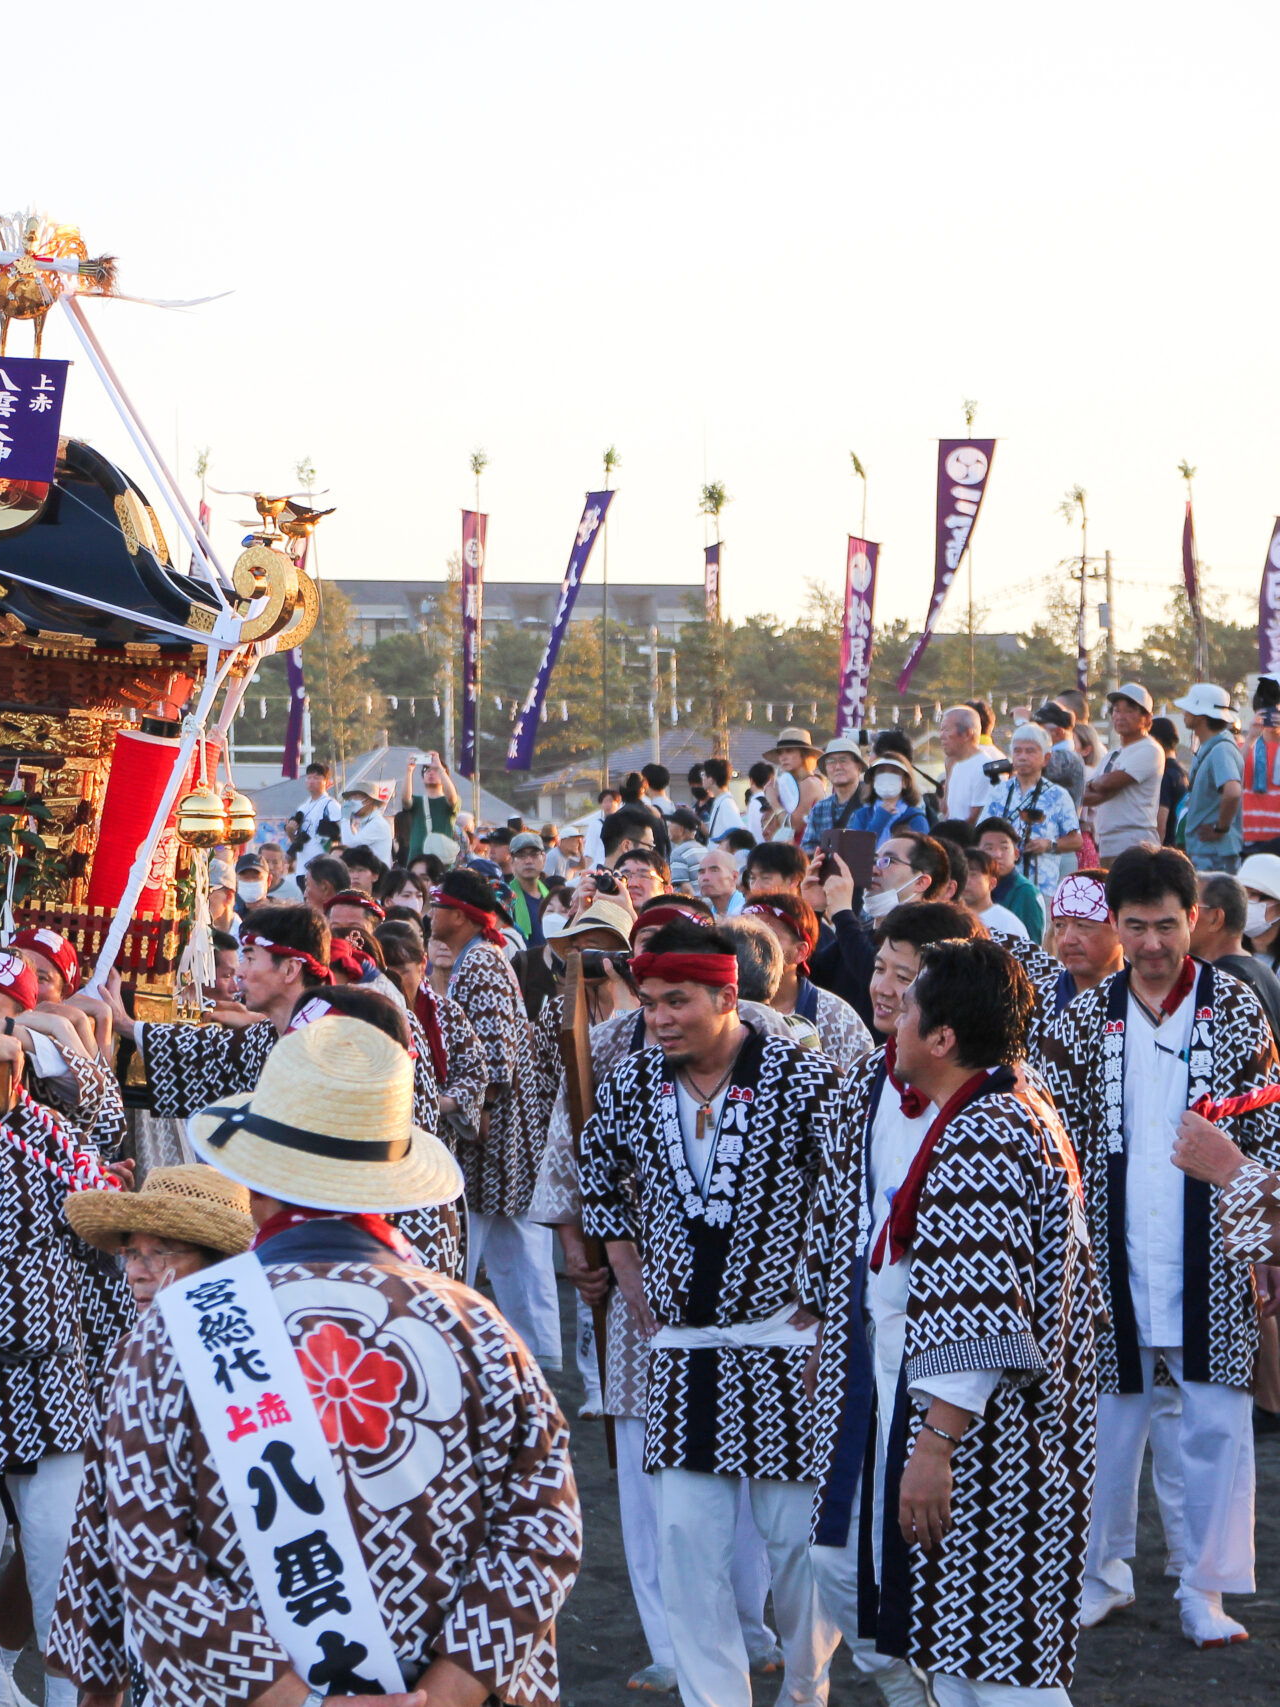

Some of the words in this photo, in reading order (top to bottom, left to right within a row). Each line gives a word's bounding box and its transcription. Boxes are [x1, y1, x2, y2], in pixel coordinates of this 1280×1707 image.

[29, 373, 56, 413] 上赤
[726, 1084, 755, 1103] 上赤
[704, 1102, 750, 1230] 八雲大神
[185, 1278, 271, 1394] 宮総代
[225, 1392, 293, 1443] 上赤
